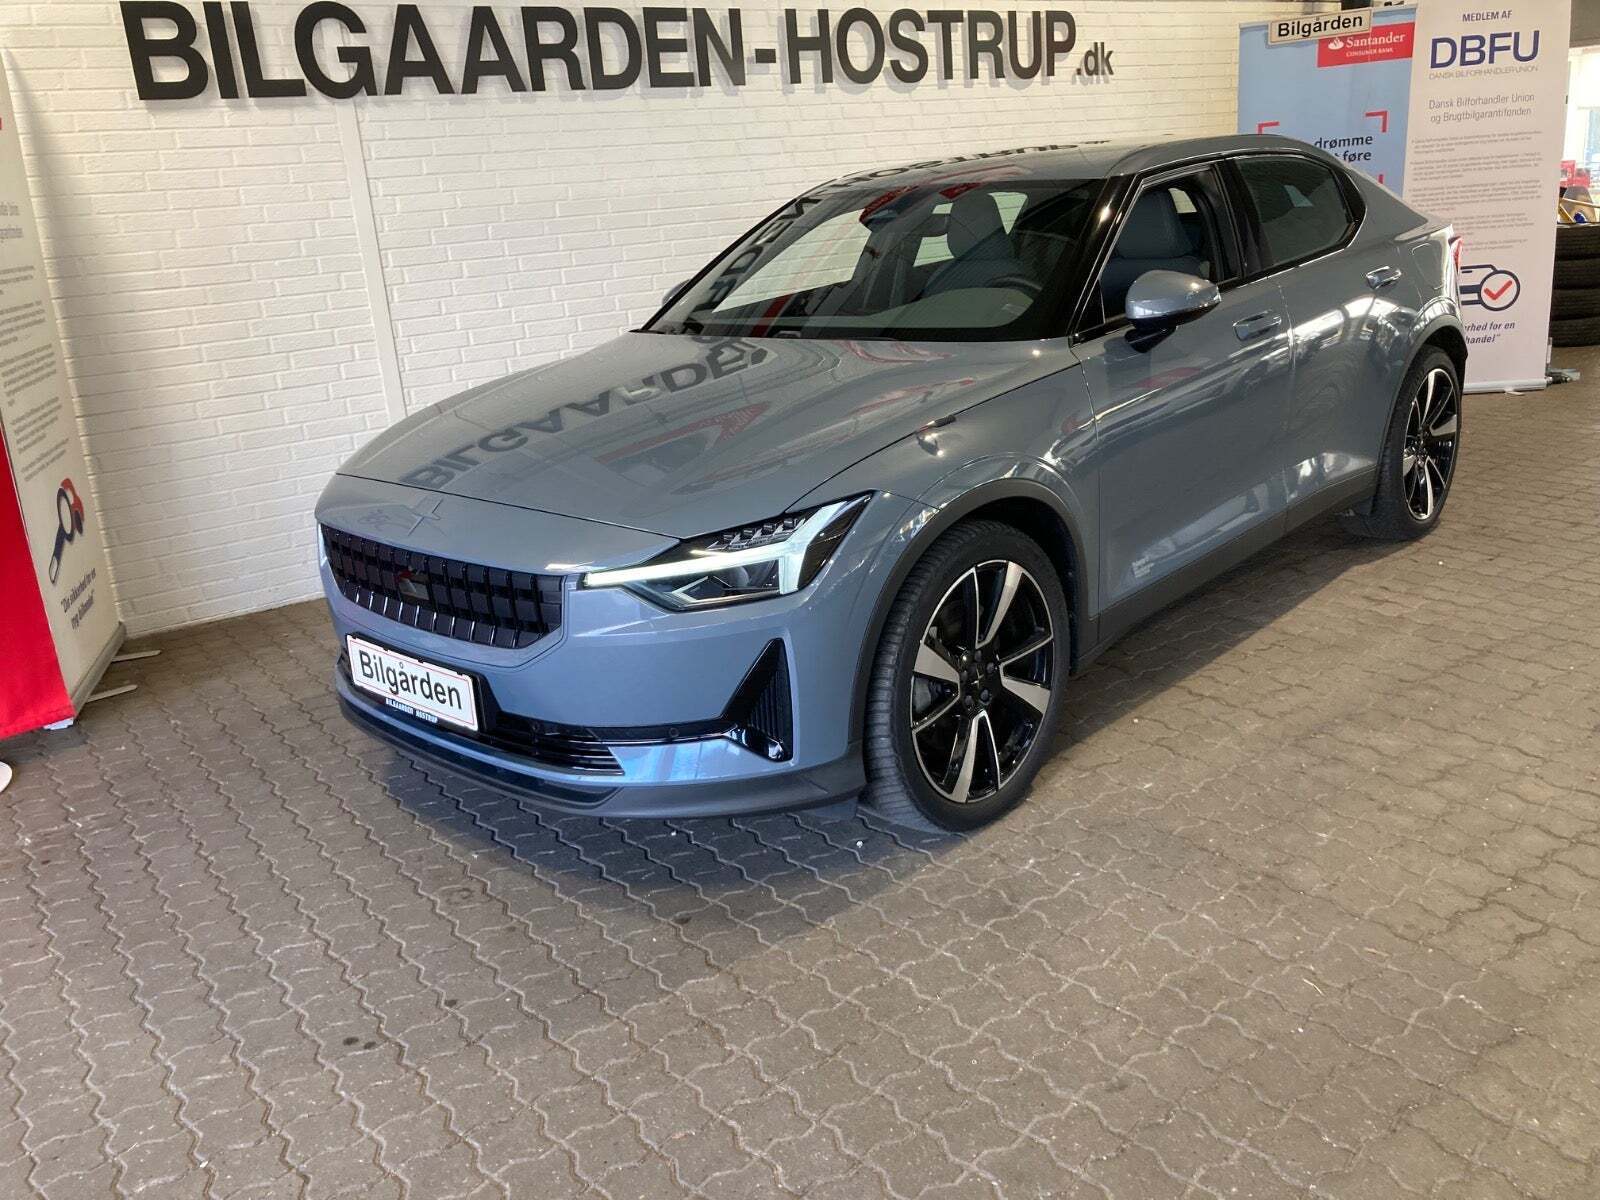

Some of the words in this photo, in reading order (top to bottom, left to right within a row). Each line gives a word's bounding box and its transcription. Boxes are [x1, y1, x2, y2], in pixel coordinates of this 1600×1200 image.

[1462, 11, 1499, 22] MEDLEM
[1501, 10, 1513, 19] AF
[1278, 14, 1363, 38] Bilgården
[1346, 32, 1406, 48] Santander
[1430, 30, 1540, 69] DBFU
[1428, 99, 1454, 109] Dansk
[1456, 94, 1509, 107] Bilforhandler
[1511, 92, 1535, 103] Union
[1430, 114, 1441, 124] og
[1314, 135, 1374, 149] drømme
[1343, 150, 1372, 163] føre
[1489, 320, 1502, 330] for
[359, 649, 462, 710] Bilgården
